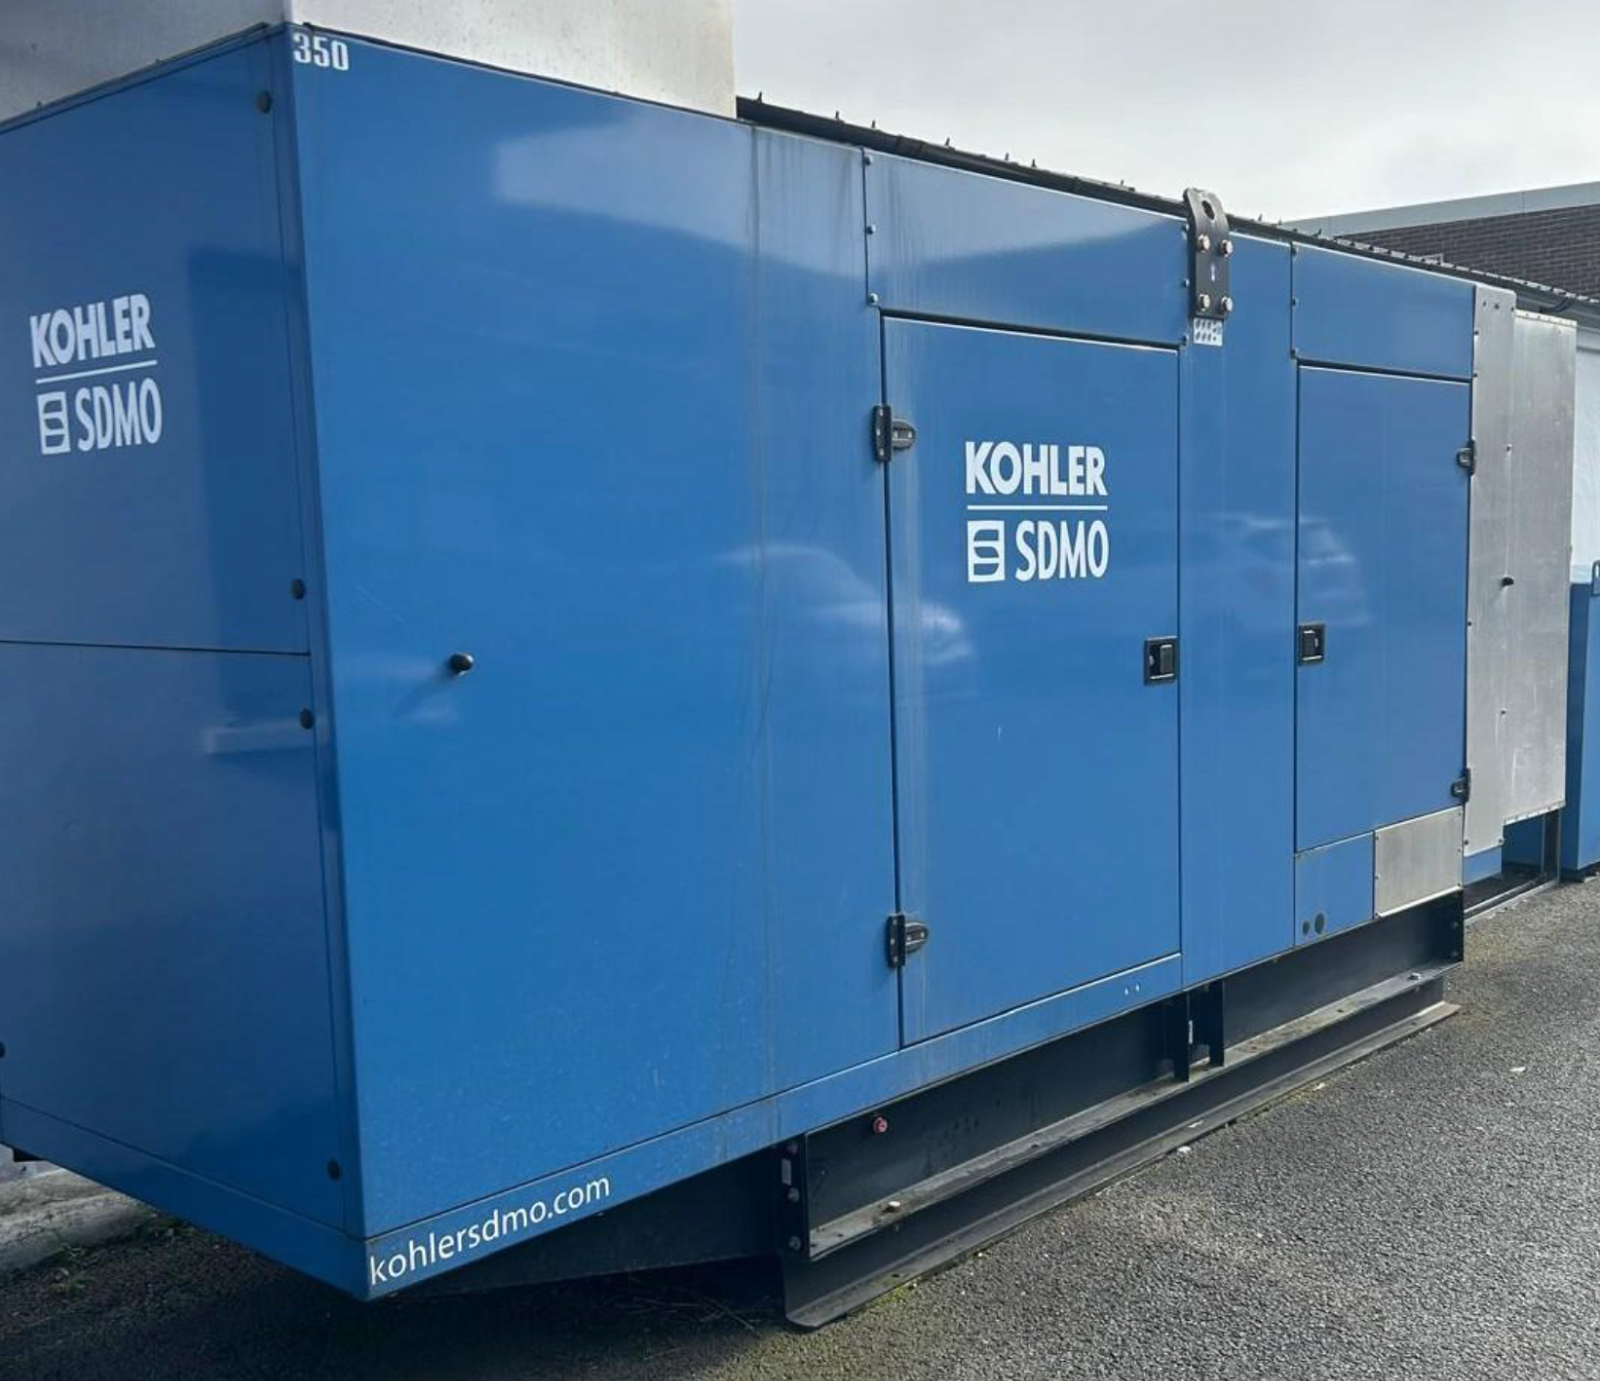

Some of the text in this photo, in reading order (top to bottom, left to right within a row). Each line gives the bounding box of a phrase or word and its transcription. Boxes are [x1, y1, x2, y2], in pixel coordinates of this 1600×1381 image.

[293, 32, 349, 71] 350
[30, 294, 156, 368] KOHLER
[75, 377, 162, 452] SDMO
[965, 441, 1108, 496] KOHLER
[1015, 520, 1109, 582] SDMO
[370, 1177, 610, 1286] kohlersdmo.com
